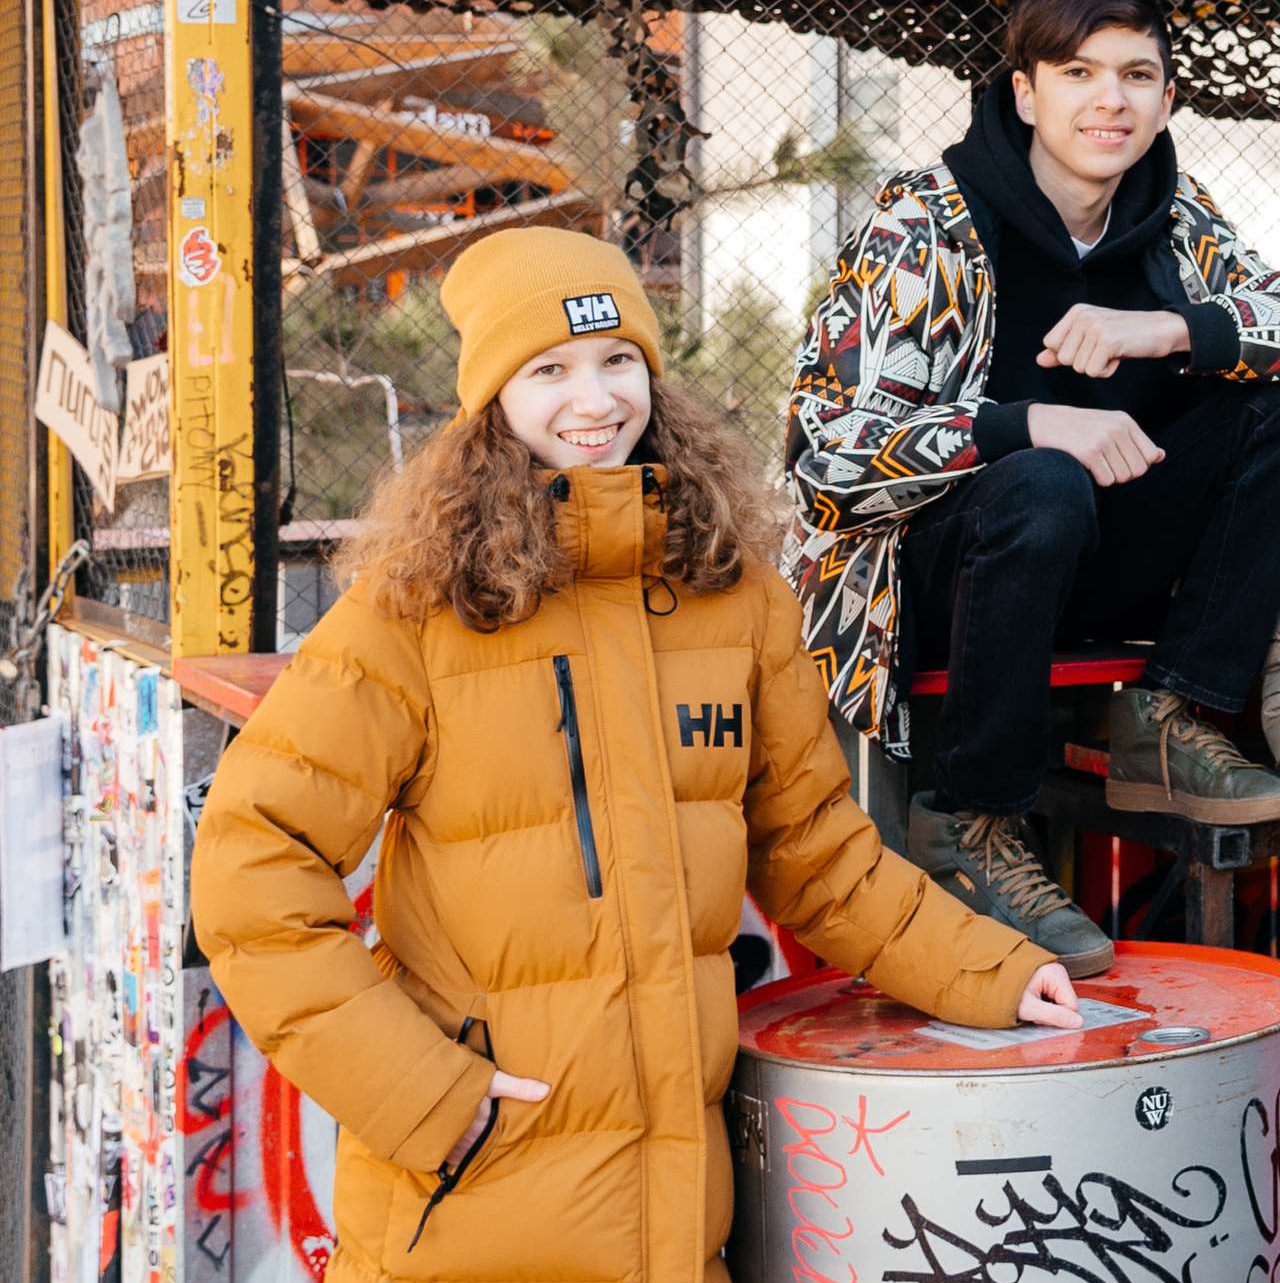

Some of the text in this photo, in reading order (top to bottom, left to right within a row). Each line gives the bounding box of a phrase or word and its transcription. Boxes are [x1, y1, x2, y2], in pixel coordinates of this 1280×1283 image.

[566, 294, 618, 325] HH
[676, 703, 743, 747] HH
[1141, 1092, 1168, 1112] NU
[1144, 1109, 1165, 1126] W
